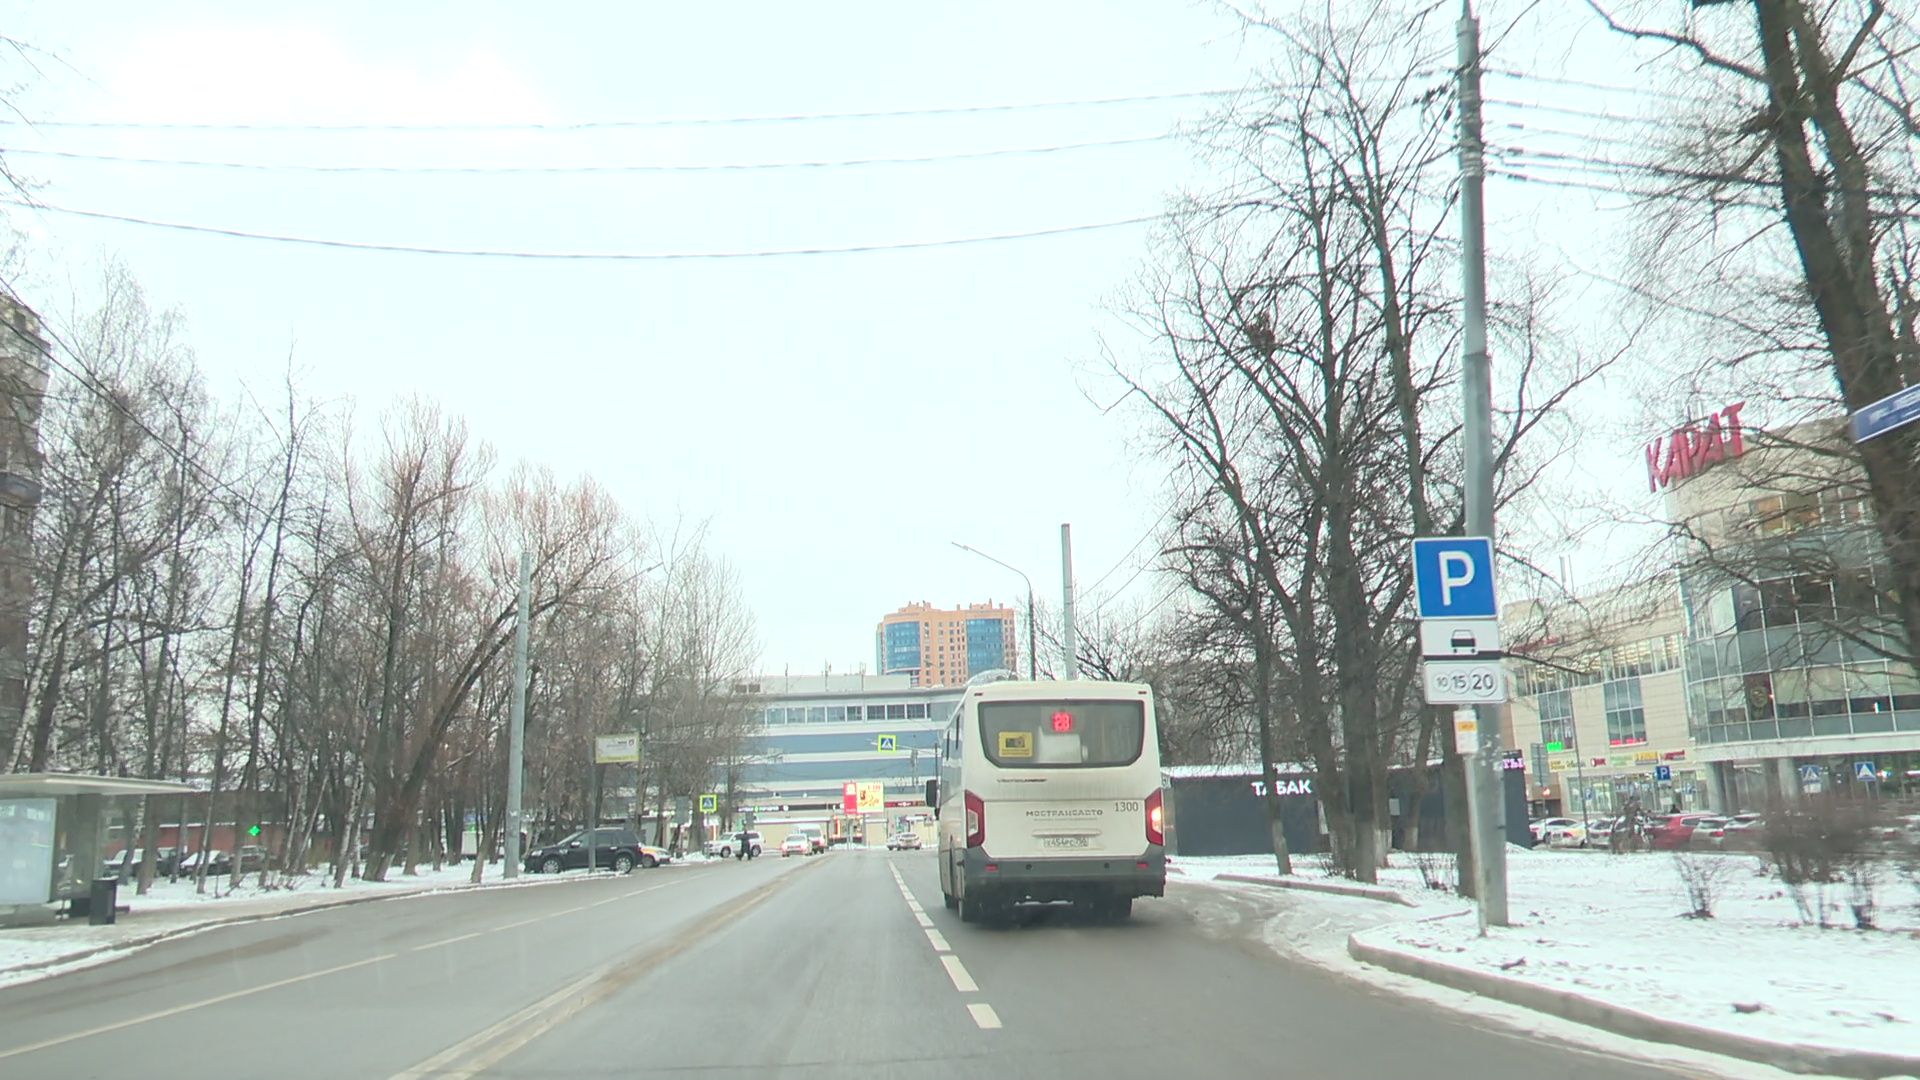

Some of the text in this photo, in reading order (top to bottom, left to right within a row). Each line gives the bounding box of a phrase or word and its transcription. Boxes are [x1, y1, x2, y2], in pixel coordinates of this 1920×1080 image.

[1645, 401, 1746, 493] КАРАТ
[1438, 550, 1476, 607] P
[1436, 674, 1494, 690] 10 15 20
[1251, 779, 1312, 796] ТБАК
[1026, 809, 1103, 817] МОСТРАНСАВТО
[1114, 802, 1139, 812] 1300
